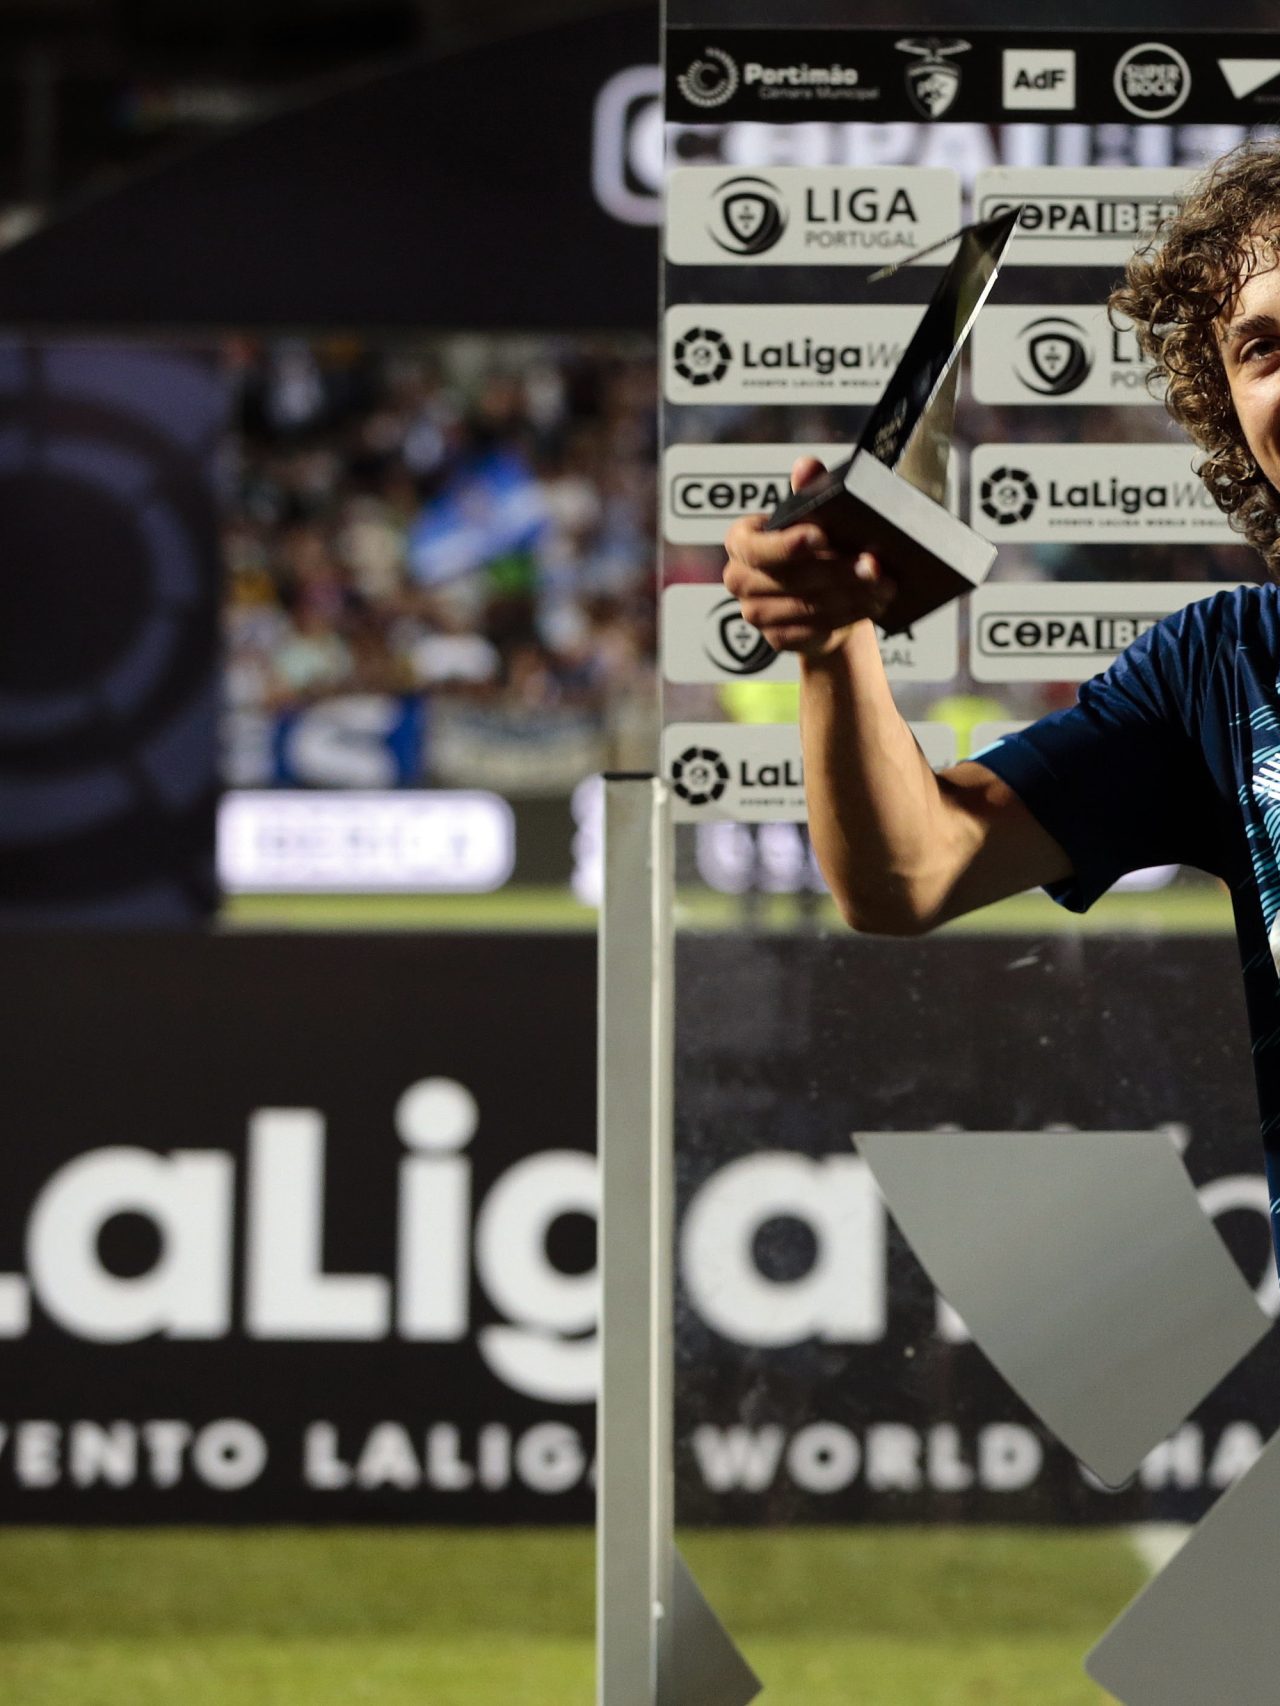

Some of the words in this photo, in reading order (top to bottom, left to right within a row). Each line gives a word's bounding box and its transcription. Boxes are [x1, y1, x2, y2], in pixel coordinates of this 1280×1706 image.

[744, 63, 858, 85] Portimão
[1013, 69, 1065, 90] AdF
[1123, 63, 1180, 80] SUPER
[1126, 79, 1178, 97] BOCK
[806, 188, 917, 223] LIGA
[805, 230, 917, 248] PORTUGAL
[0, 1419, 268, 1491] ENTO
[304, 1421, 597, 1495] LALIG
[693, 1420, 1044, 1492] WORLD
